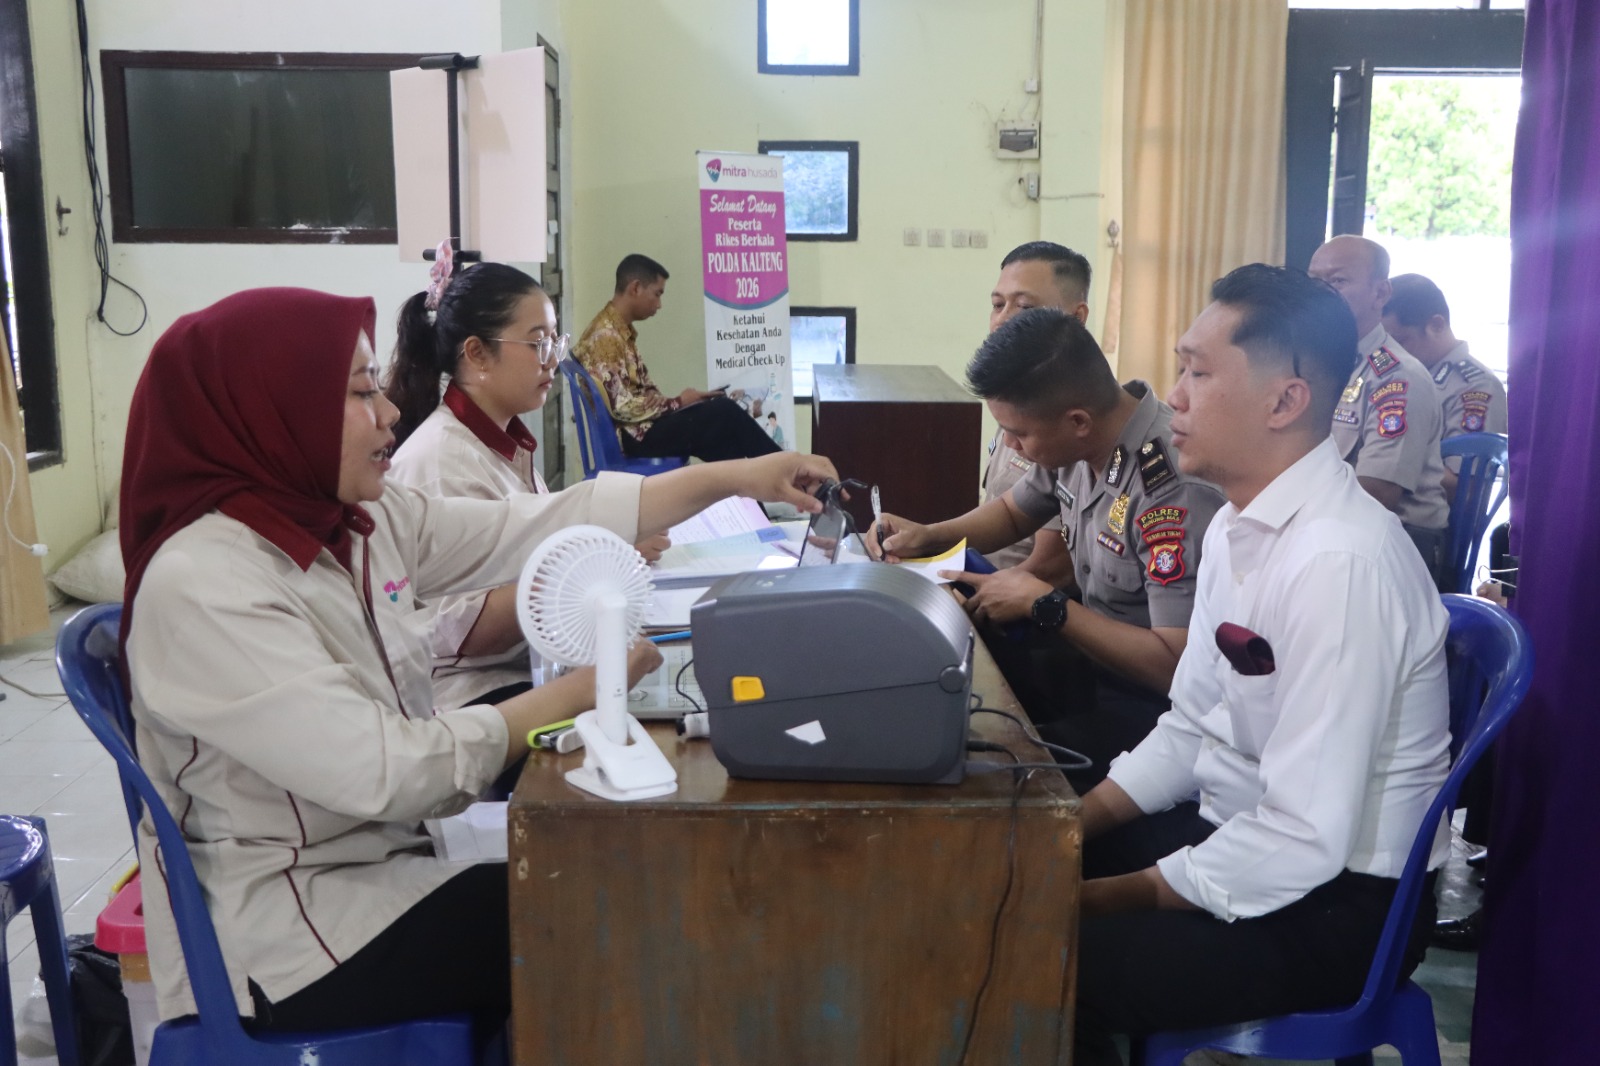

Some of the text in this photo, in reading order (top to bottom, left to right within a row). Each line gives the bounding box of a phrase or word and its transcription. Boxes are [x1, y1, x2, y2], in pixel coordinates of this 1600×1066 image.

[722, 164, 778, 179] mitra husada
[709, 193, 777, 218] Selamat Datang
[728, 217, 762, 231] Peserta
[715, 233, 775, 247] Rikes Berkala
[707, 251, 783, 273] POLDA KALTENG
[736, 277, 760, 299] 2026
[733, 313, 766, 326] Ketahui
[716, 326, 782, 341] Kesehatan Anda
[735, 342, 766, 356] Dengan
[715, 353, 786, 370] Medical Check Up
[1141, 508, 1180, 524] POLRES
